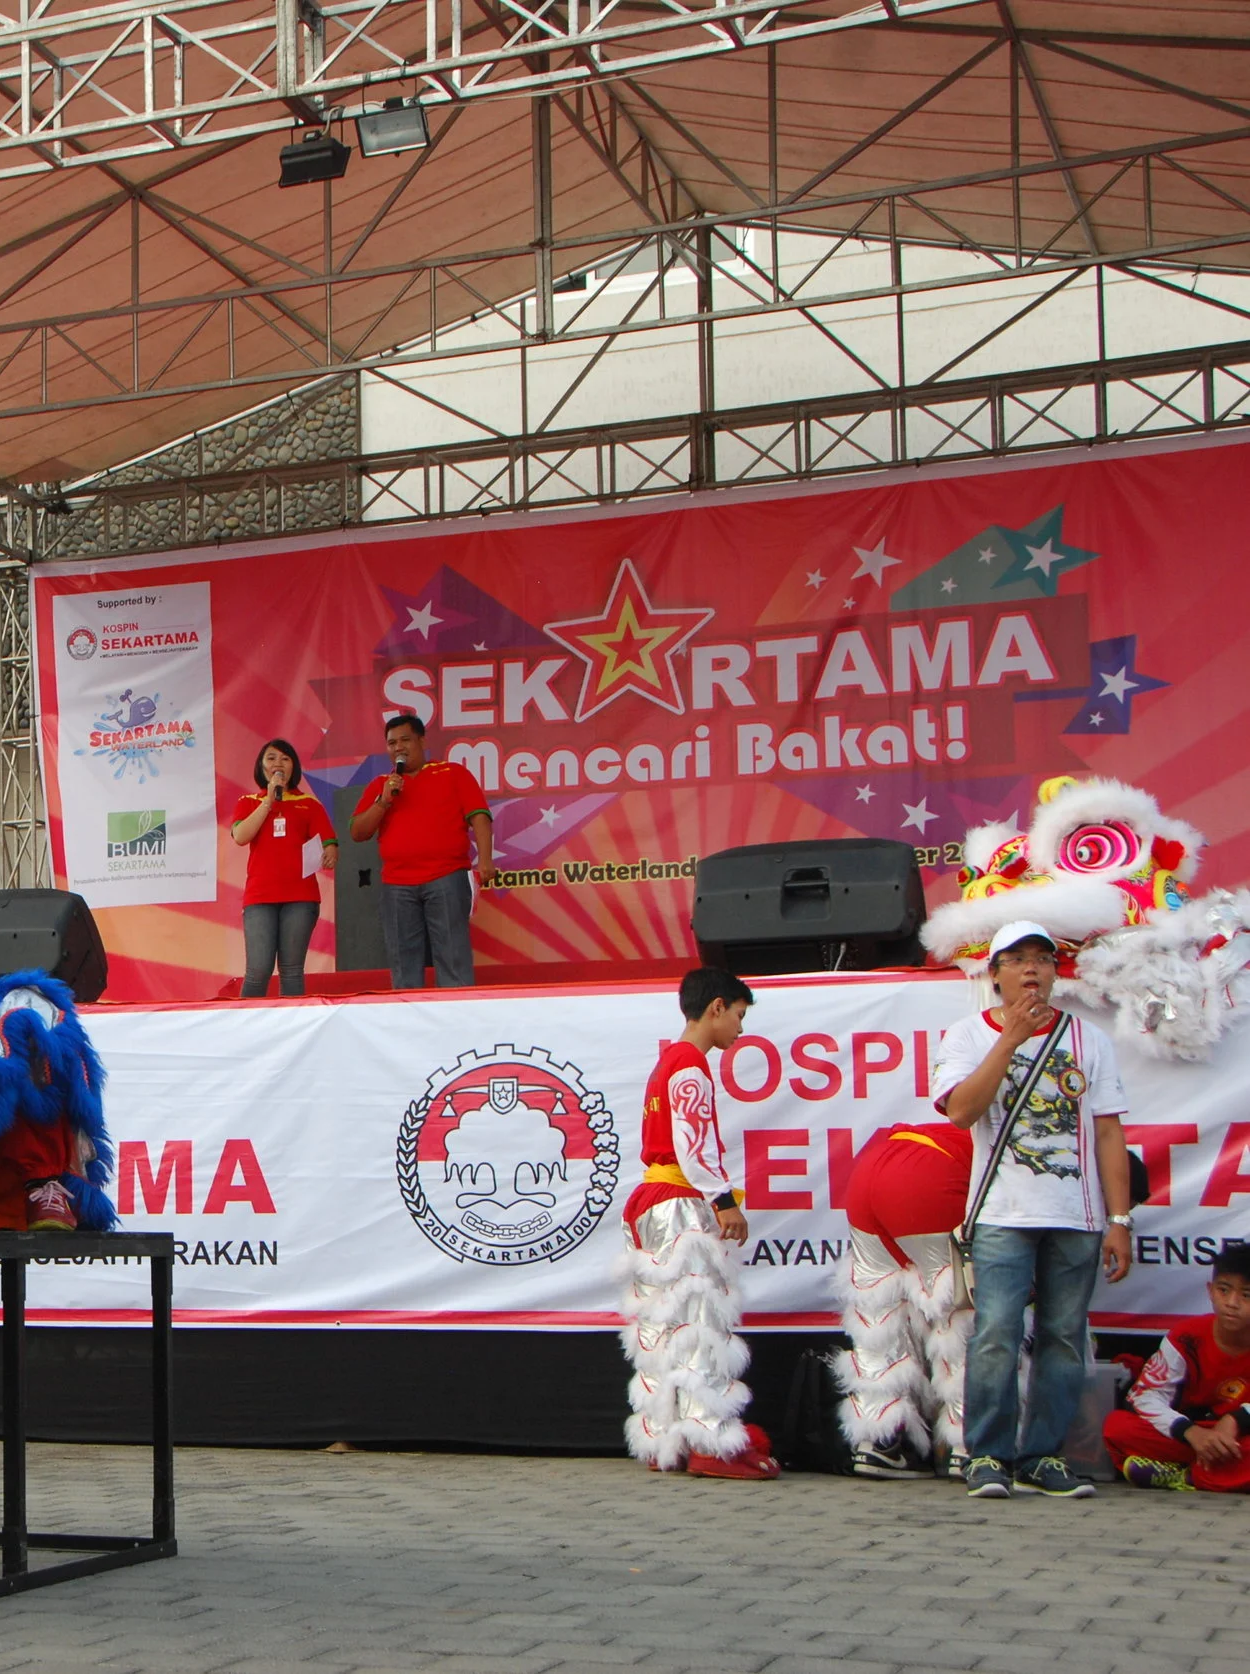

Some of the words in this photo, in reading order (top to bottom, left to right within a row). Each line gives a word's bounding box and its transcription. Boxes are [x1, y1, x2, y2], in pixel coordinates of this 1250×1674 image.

[97, 596, 143, 610] Supported
[145, 595, 157, 606] by
[102, 622, 139, 634] KOSPIN
[101, 631, 199, 651] SEKARTAMA
[90, 720, 193, 747] SEKARTAMA
[111, 738, 185, 751] WATERLAND
[450, 726, 710, 791] Mencari
[738, 706, 966, 770] Bakat!
[112, 840, 165, 857] BUMI
[108, 859, 166, 872] SEKARTAMA
[563, 856, 697, 881] Waterland
[423, 1218, 442, 1238] 20
[448, 1234, 567, 1262] SEKARTAMA
[573, 1216, 593, 1237] 00
